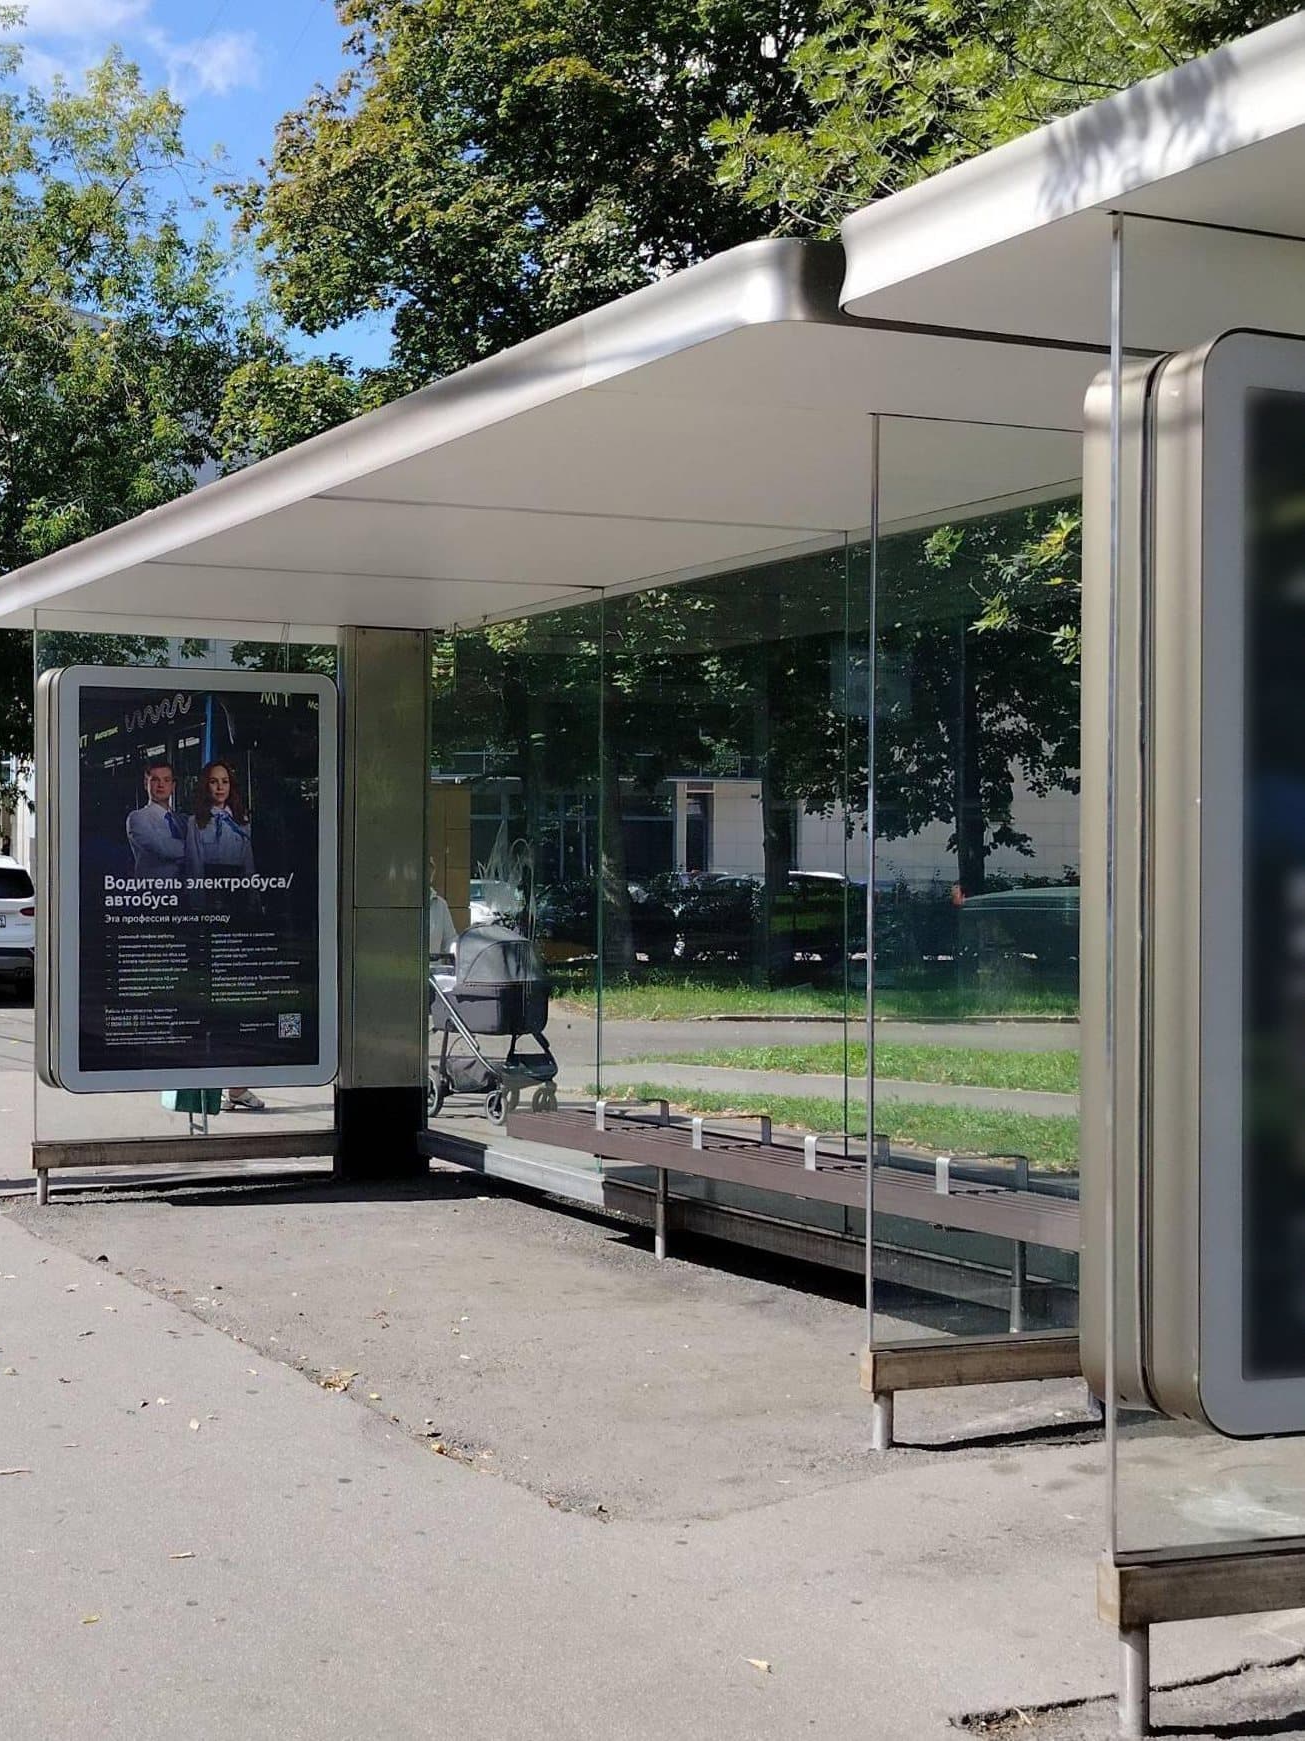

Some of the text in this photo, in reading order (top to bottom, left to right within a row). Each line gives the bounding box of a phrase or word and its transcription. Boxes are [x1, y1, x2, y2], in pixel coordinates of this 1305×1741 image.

[104, 872, 294, 892] Водитель электробуса/
[104, 891, 179, 910] автобуса
[104, 914, 231, 924] Эта профессия нужна городу
